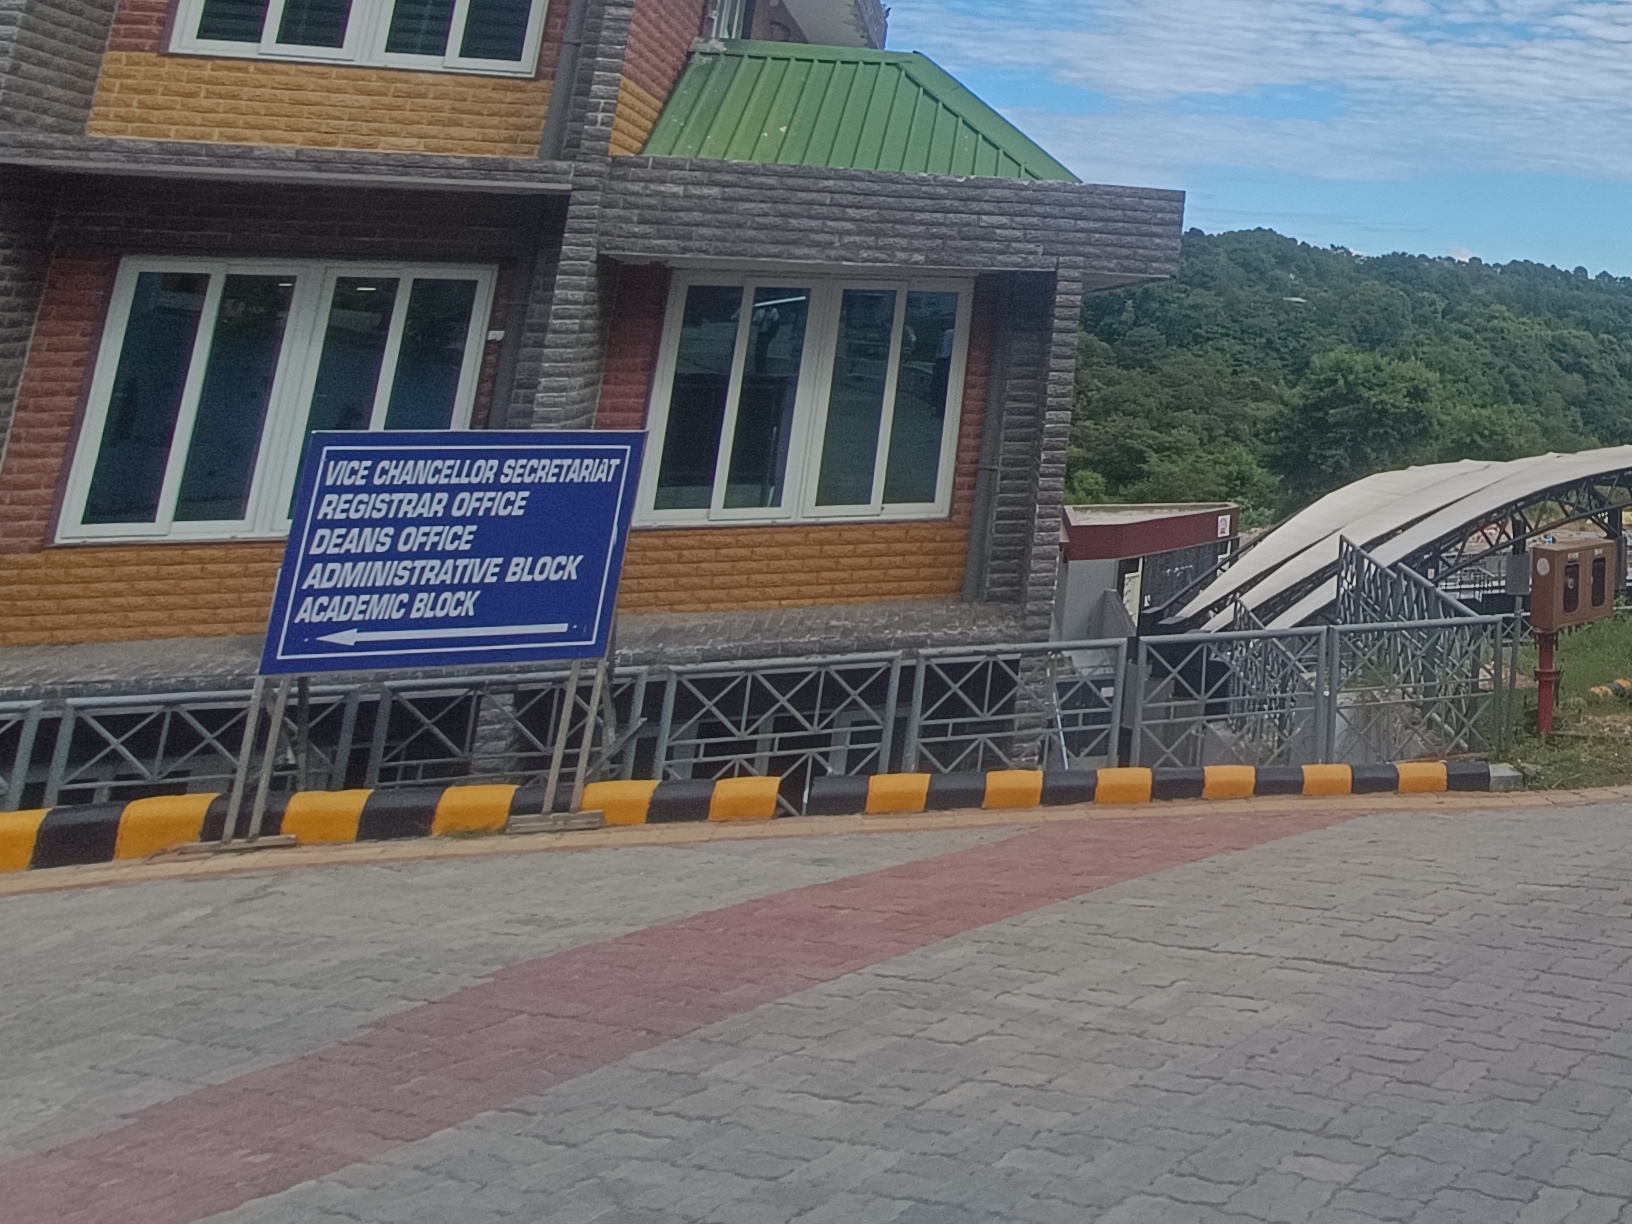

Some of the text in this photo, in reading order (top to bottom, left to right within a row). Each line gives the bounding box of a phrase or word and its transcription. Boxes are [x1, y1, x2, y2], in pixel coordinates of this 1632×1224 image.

[325, 458, 620, 486] VICE CHANCELLOR SECRETARIAT
[317, 491, 530, 520] REGISTRAR OFFICE
[309, 525, 477, 555] DEANS OFFICE
[301, 555, 584, 589] ADMINISTRATIVE BLOCK
[294, 590, 481, 623] ACADEMIC BLOCK
